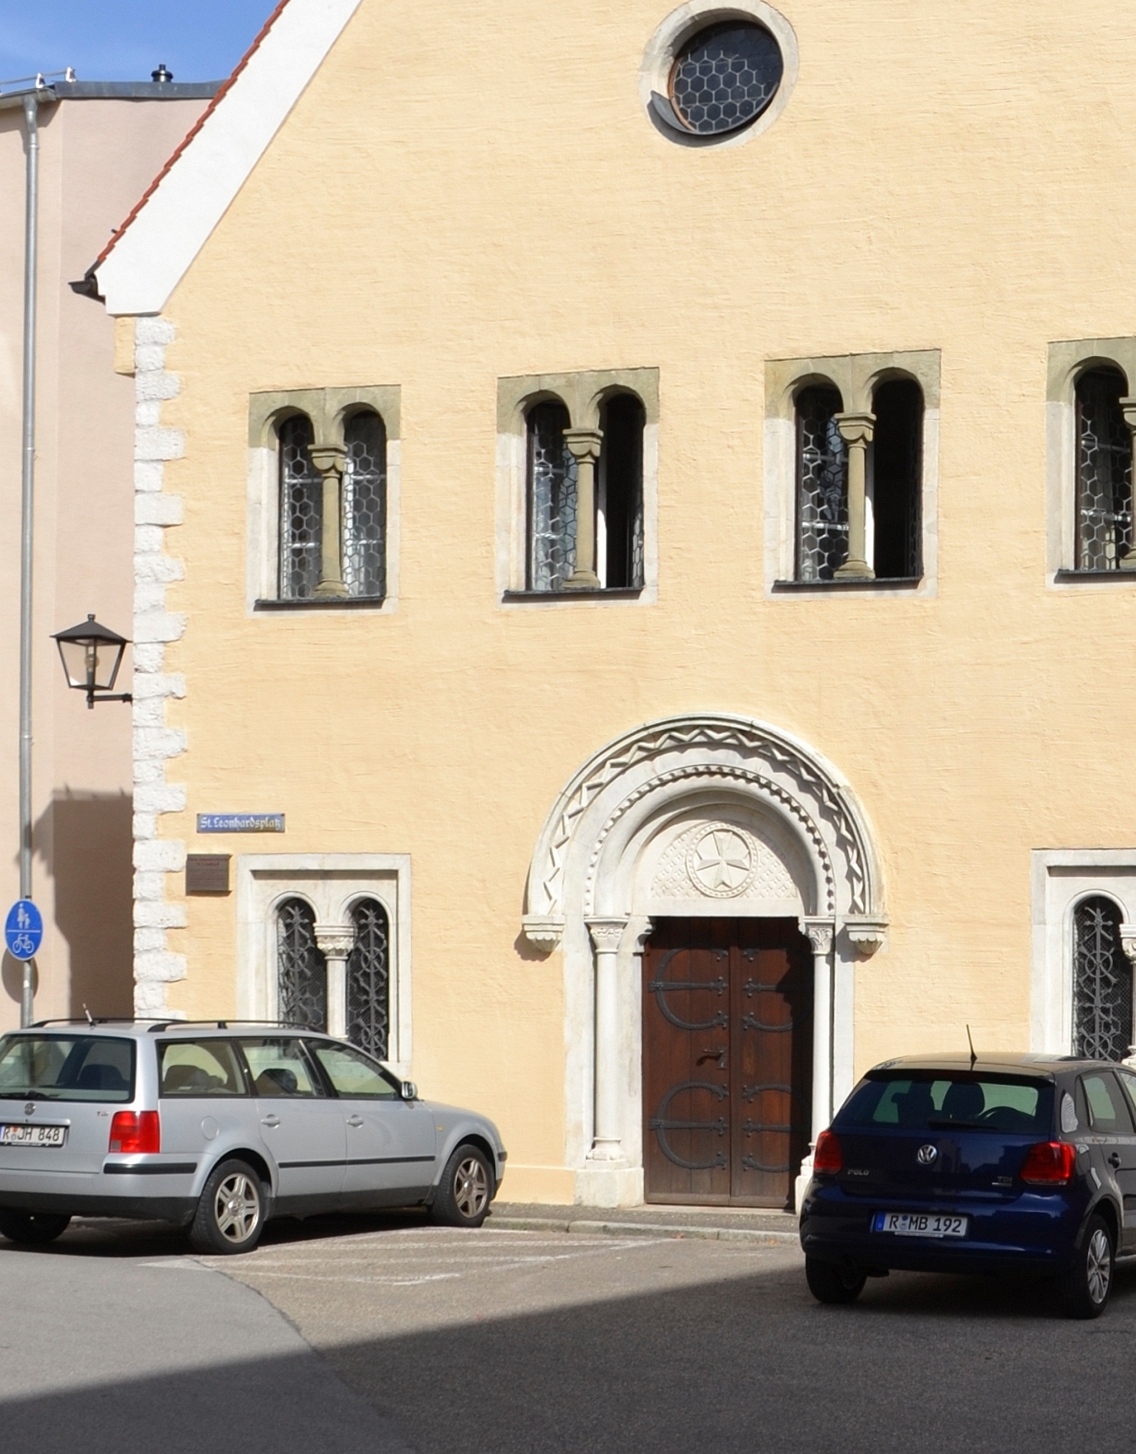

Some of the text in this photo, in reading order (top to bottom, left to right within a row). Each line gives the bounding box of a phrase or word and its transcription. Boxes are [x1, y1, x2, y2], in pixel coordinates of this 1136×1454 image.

[2, 1126, 11, 1140] R
[38, 1128, 61, 1142] 848
[847, 1168, 870, 1177] POLO
[889, 1215, 962, 1234] R MB 192
